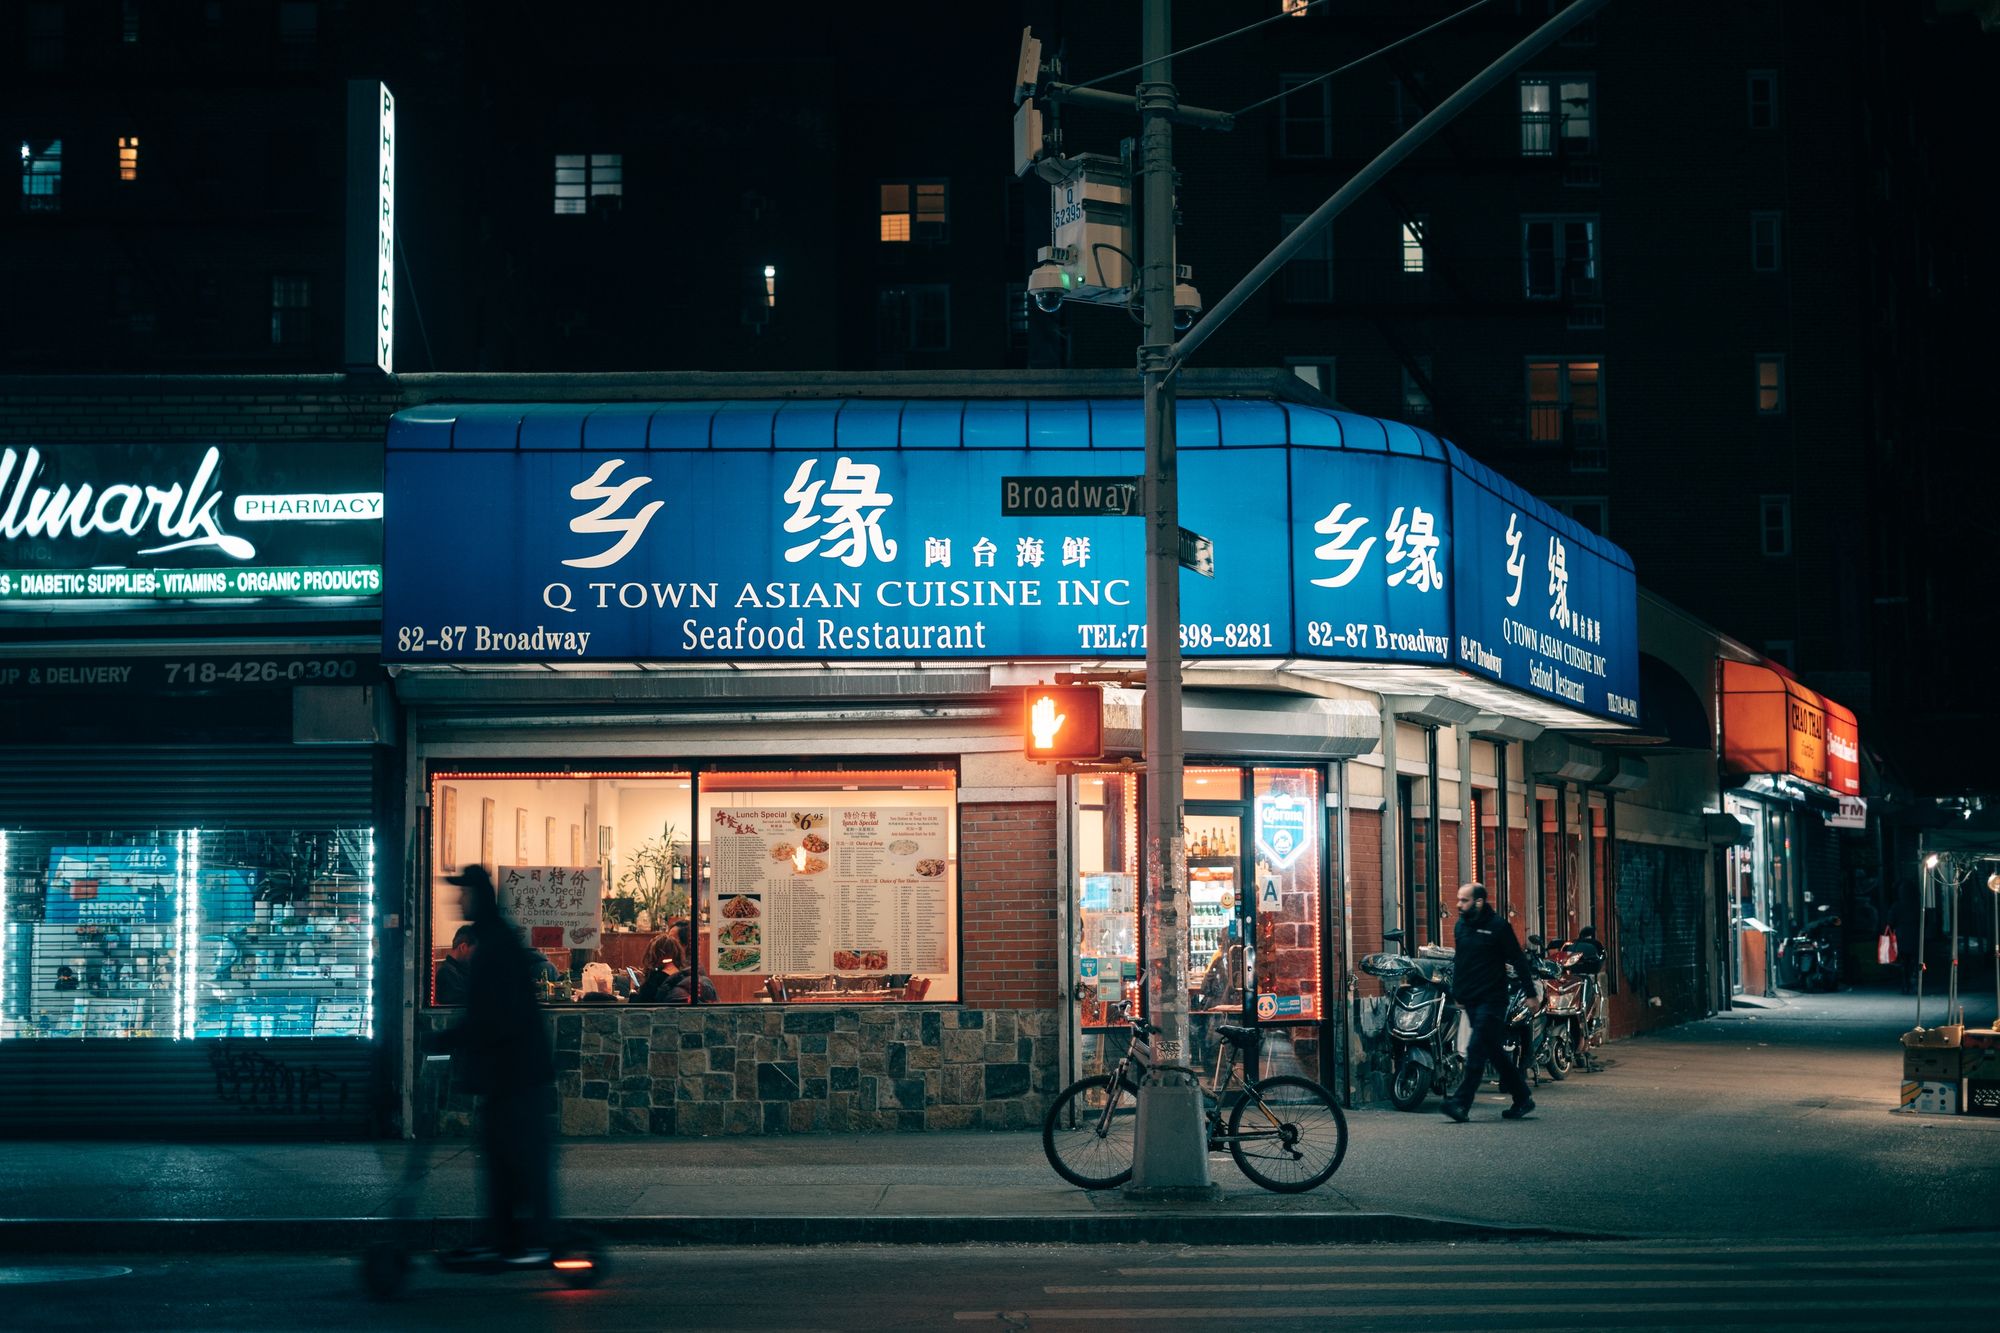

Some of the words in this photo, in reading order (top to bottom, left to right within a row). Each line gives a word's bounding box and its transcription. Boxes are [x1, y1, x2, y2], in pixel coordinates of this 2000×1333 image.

[1067, 188, 1073, 204] Q
[1055, 203, 1081, 228] 52395
[380, 91, 392, 366] PHARMACY
[246, 499, 380, 514] PHARMACY
[1007, 480, 1133, 515] Broadway
[925, 536, 1091, 568] 闽台海鲜
[1310, 502, 1443, 592] 乡缘
[0, 575, 10, 594] S
[21, 574, 84, 594] DIABETIC
[163, 573, 226, 593] VITAMINS
[237, 572, 300, 592] ORGANIC
[304, 570, 379, 590] PRODUCTS
[1506, 512, 1570, 630] 乡缘
[543, 582, 576, 612] Q
[589, 583, 718, 609] TOWN
[735, 582, 862, 609] ASIAN
[876, 581, 1042, 607] CUISINE
[1057, 580, 1130, 606] INC
[398, 625, 467, 652] 82-87
[475, 625, 590, 655] Broadway
[682, 617, 805, 650] Seafood
[817, 619, 986, 650] Restaurant
[1307, 621, 1367, 648] 82-87
[1374, 624, 1449, 659] Broadway
[1503, 617, 1512, 645] Q
[1512, 621, 1538, 652] TOWN
[1539, 633, 1563, 662] ASIAN
[1564, 643, 1592, 673] CUISINE
[1594, 656, 1607, 678] INC
[164, 660, 357, 683] 718-426-0300
[1477, 642, 1502, 678] Broadway
[46, 666, 132, 685] DELIVERY
[1529, 659, 1553, 692] Seafood
[1555, 669, 1585, 704] Restaurant
[1792, 703, 1808, 734] CHAO
[1809, 712, 1822, 740] THAI
[760, 811, 787, 819] Special
[793, 812, 824, 831] $6.95
[1263, 806, 1304, 824] Corona
[1840, 803, 1863, 816] TM
[842, 819, 859, 827] Lunch
[859, 819, 879, 827] Special
[124, 849, 168, 867] 4Life
[505, 867, 590, 888] 今日特价
[509, 886, 545, 896] Today's
[551, 885, 586, 897] Special
[1263, 880, 1278, 901] A
